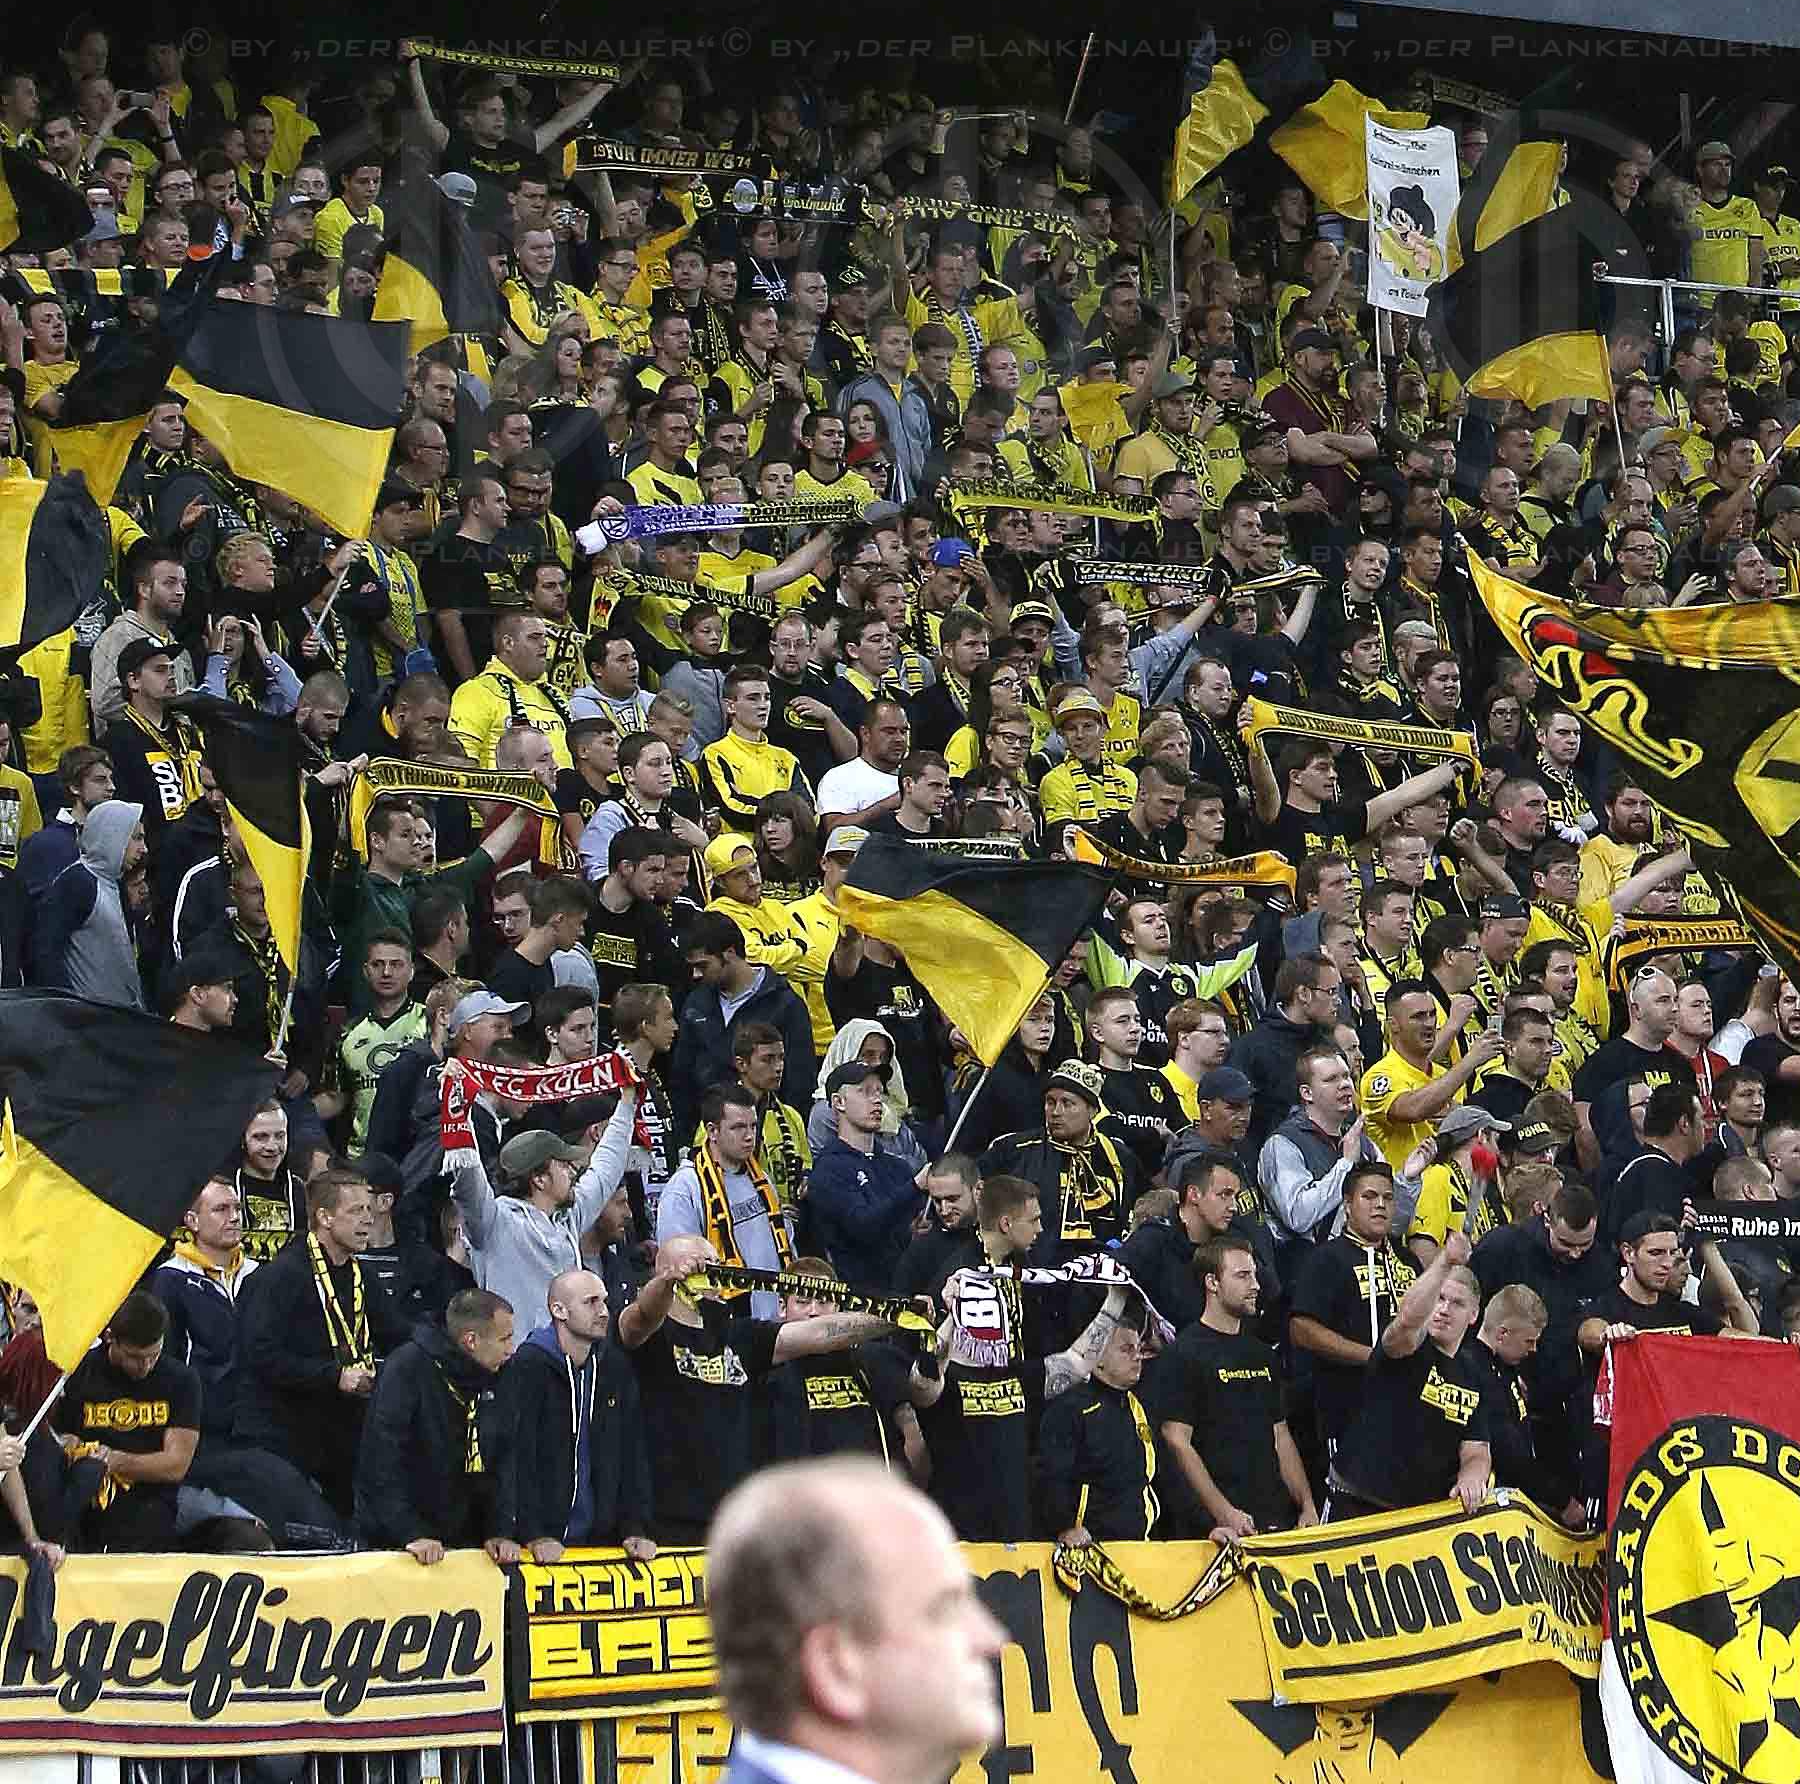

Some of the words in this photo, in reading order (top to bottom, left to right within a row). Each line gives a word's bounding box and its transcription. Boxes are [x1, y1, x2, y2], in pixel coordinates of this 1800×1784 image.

[535, 1062, 615, 1094] KÖLN
[1730, 1215, 1779, 1237] Ruhe
[1259, 1553, 1464, 1649] Sektion
